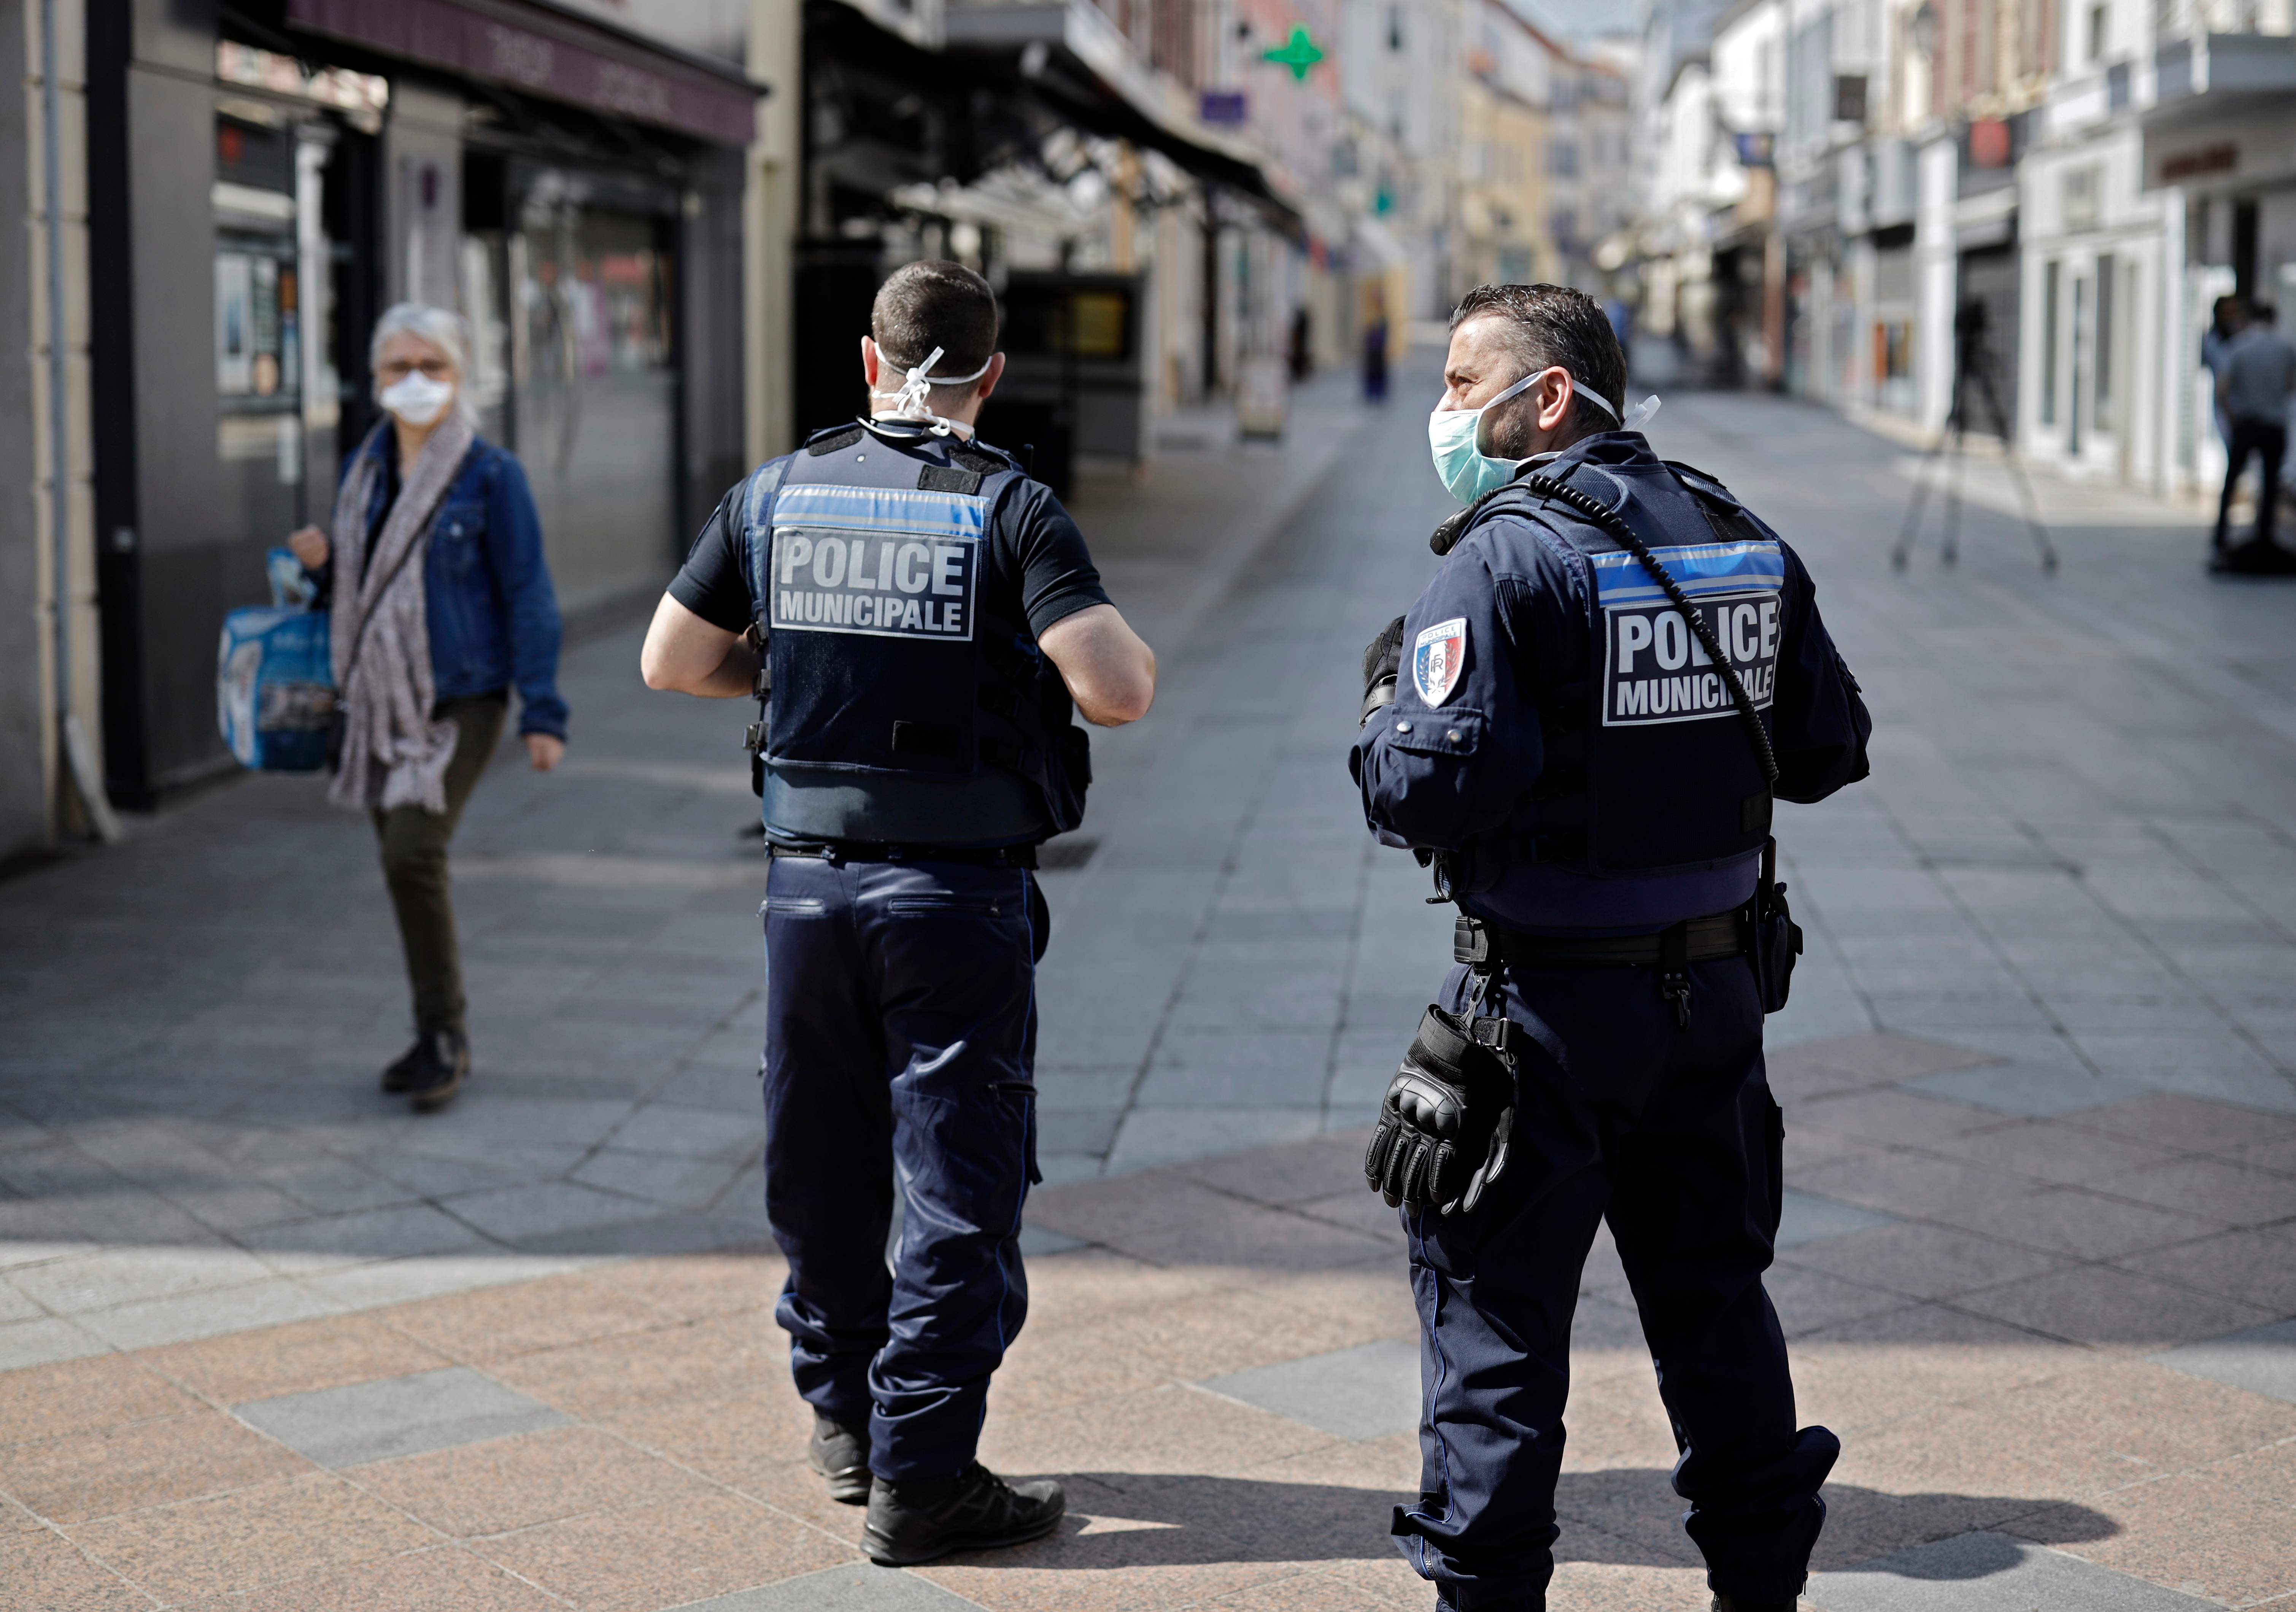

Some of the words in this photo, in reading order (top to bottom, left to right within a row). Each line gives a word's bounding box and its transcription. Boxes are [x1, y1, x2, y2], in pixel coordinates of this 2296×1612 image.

[780, 535, 965, 596] POLICE
[780, 590, 962, 632] MUNICIPALE
[1423, 626, 1455, 638] POLICE
